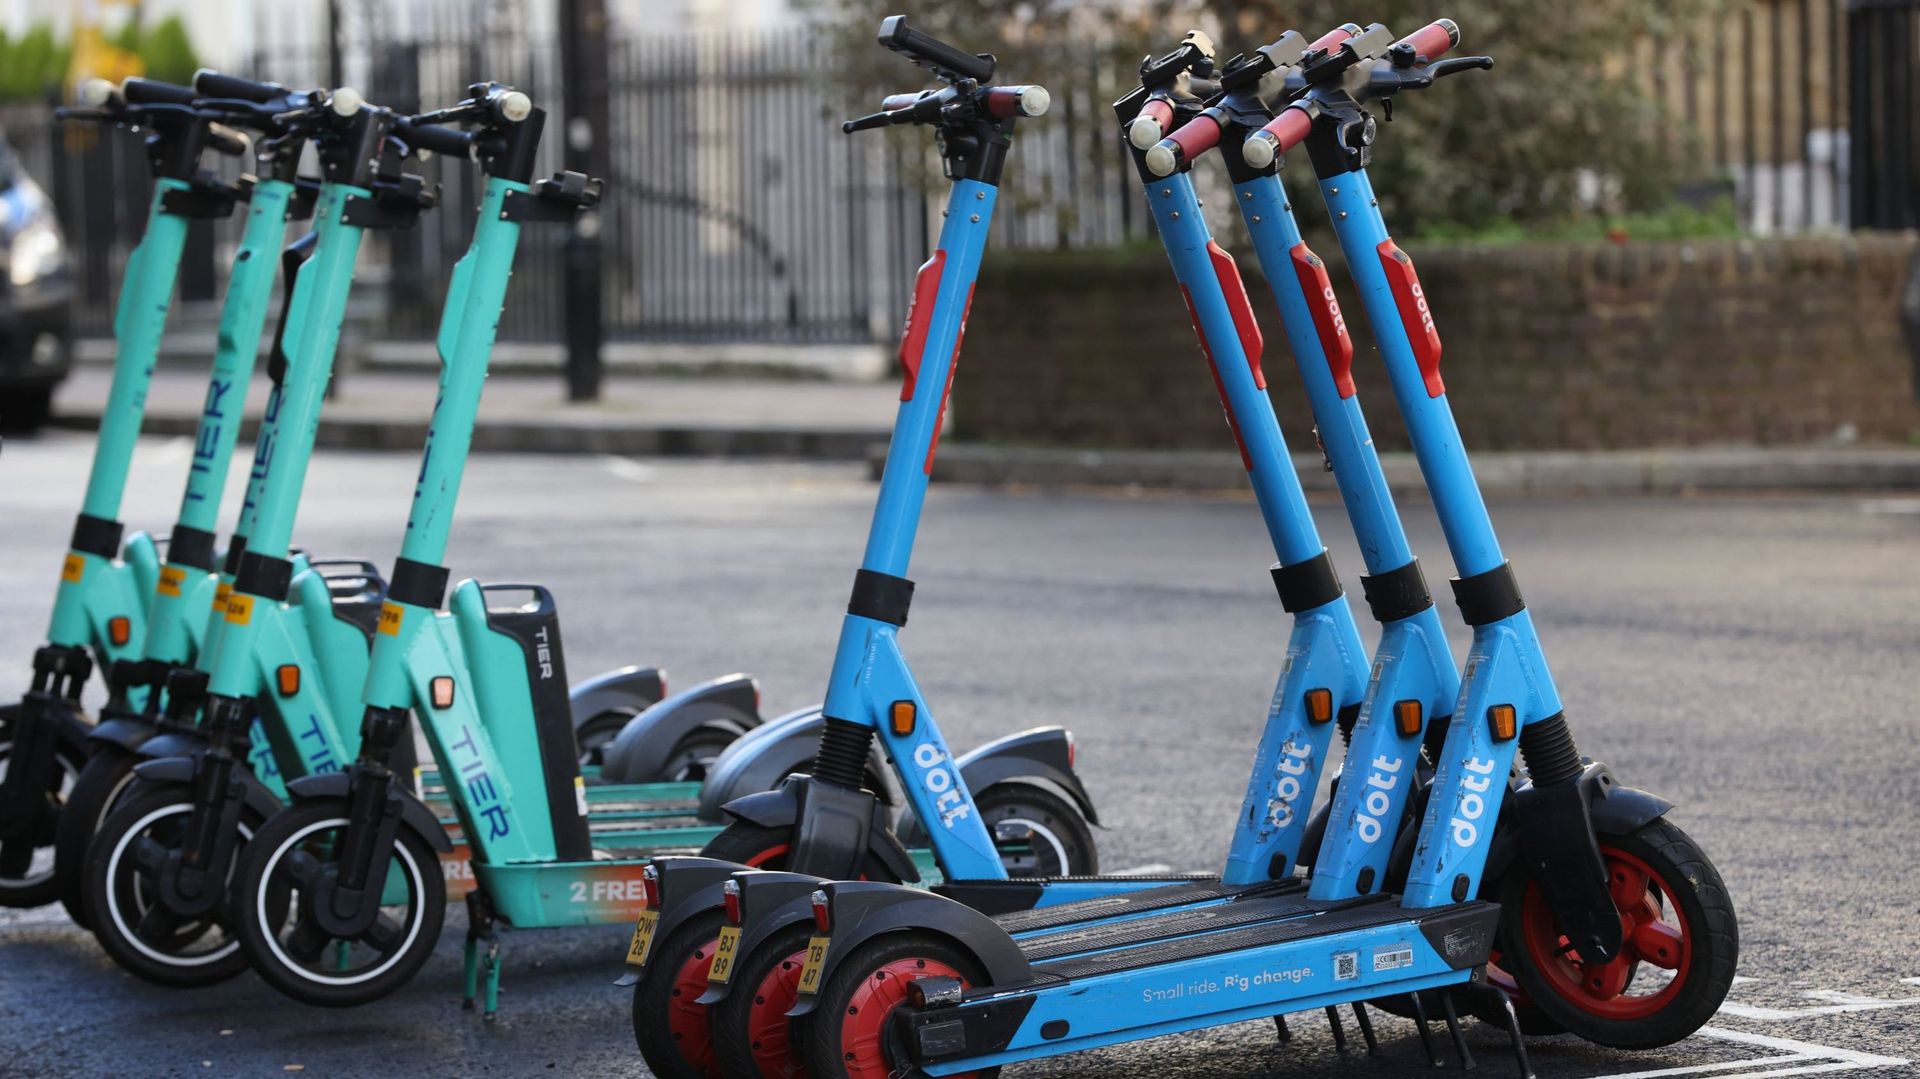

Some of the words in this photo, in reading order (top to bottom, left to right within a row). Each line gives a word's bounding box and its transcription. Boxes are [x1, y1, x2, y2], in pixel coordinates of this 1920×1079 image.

[535, 626, 553, 680] TIER
[301, 714, 338, 775] TIE
[452, 724, 511, 843] TIER
[914, 743, 970, 829] dott
[1356, 754, 1402, 843] dott
[1450, 756, 1495, 848] dott
[569, 881, 587, 902] 2
[632, 940, 645, 956] 28
[719, 935, 734, 952] BJ
[810, 946, 823, 964] TB
[713, 958, 729, 975] 89
[803, 969, 817, 986] 47
[1143, 983, 1184, 1003] Small
[1188, 979, 1220, 995] ride.
[1253, 967, 1315, 985] change.
